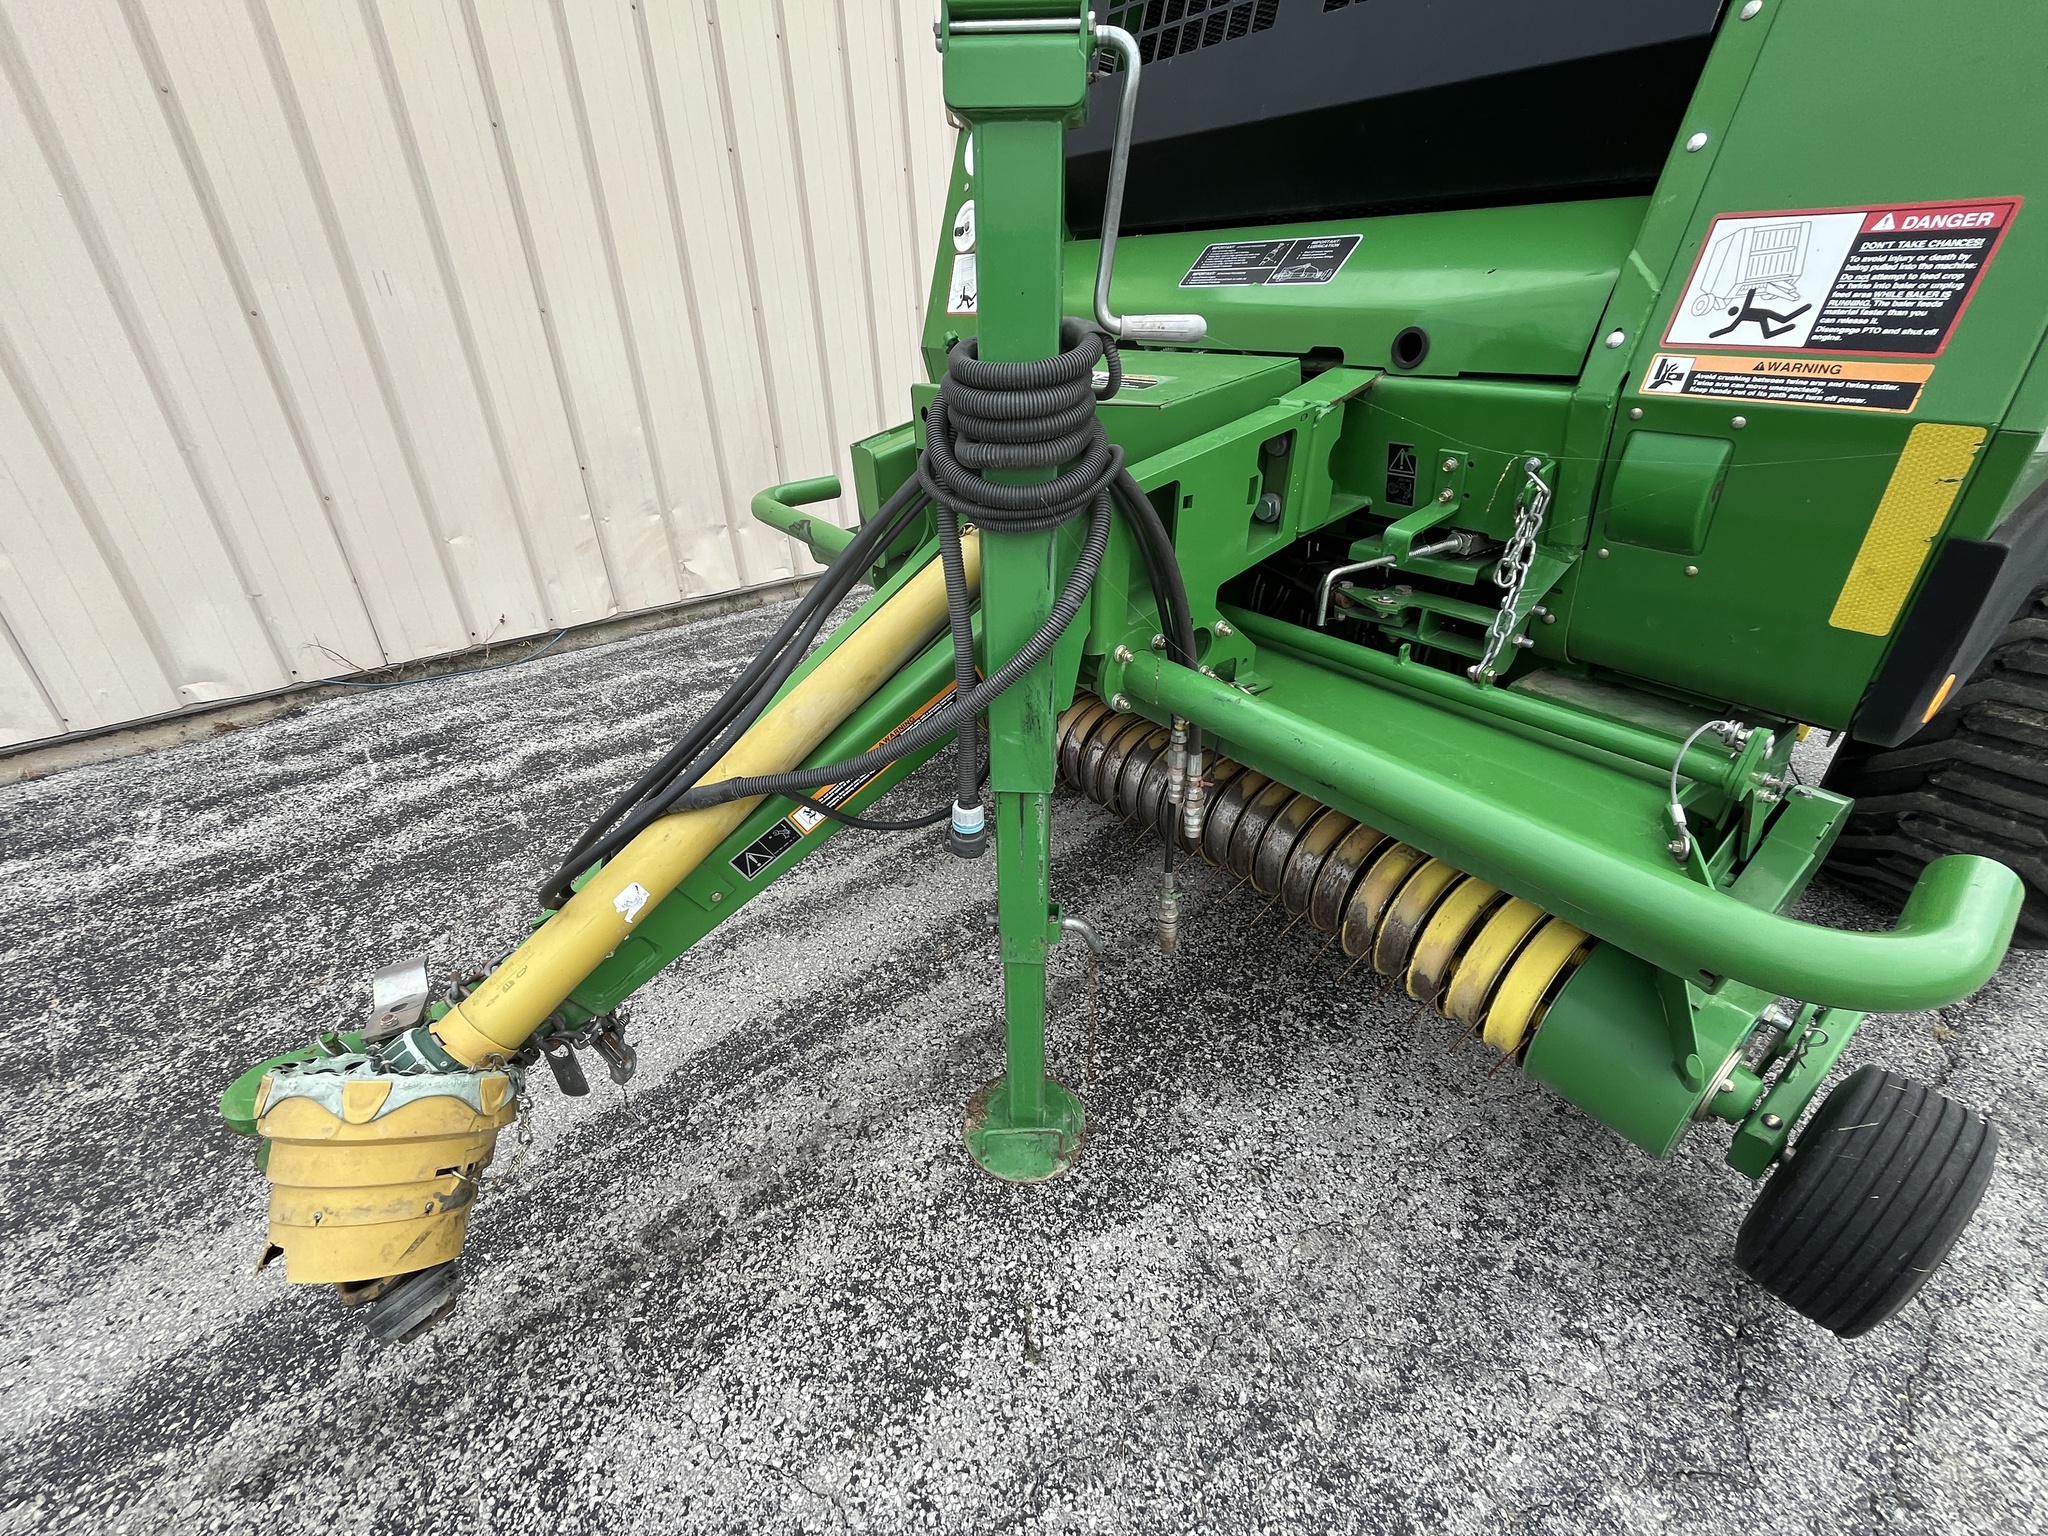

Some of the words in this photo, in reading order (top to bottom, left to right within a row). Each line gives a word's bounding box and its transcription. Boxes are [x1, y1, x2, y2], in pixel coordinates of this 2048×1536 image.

[1901, 212, 1994, 229] DANGER
[1861, 241, 1896, 249] DON'T
[1899, 239, 1927, 248] TAKE
[1928, 238, 1986, 247] CHANCES!
[1888, 254, 1916, 263] injury
[1929, 253, 1956, 261] death
[1958, 253, 1971, 262] by
[1845, 264, 1869, 272] being
[1869, 263, 1898, 272] pulled
[1870, 273, 1906, 281] attempt
[1909, 310, 1928, 318] you
[1815, 326, 1861, 334] Disengage
[1768, 362, 1842, 375] WARNING
[883, 716, 915, 743] WARNING
